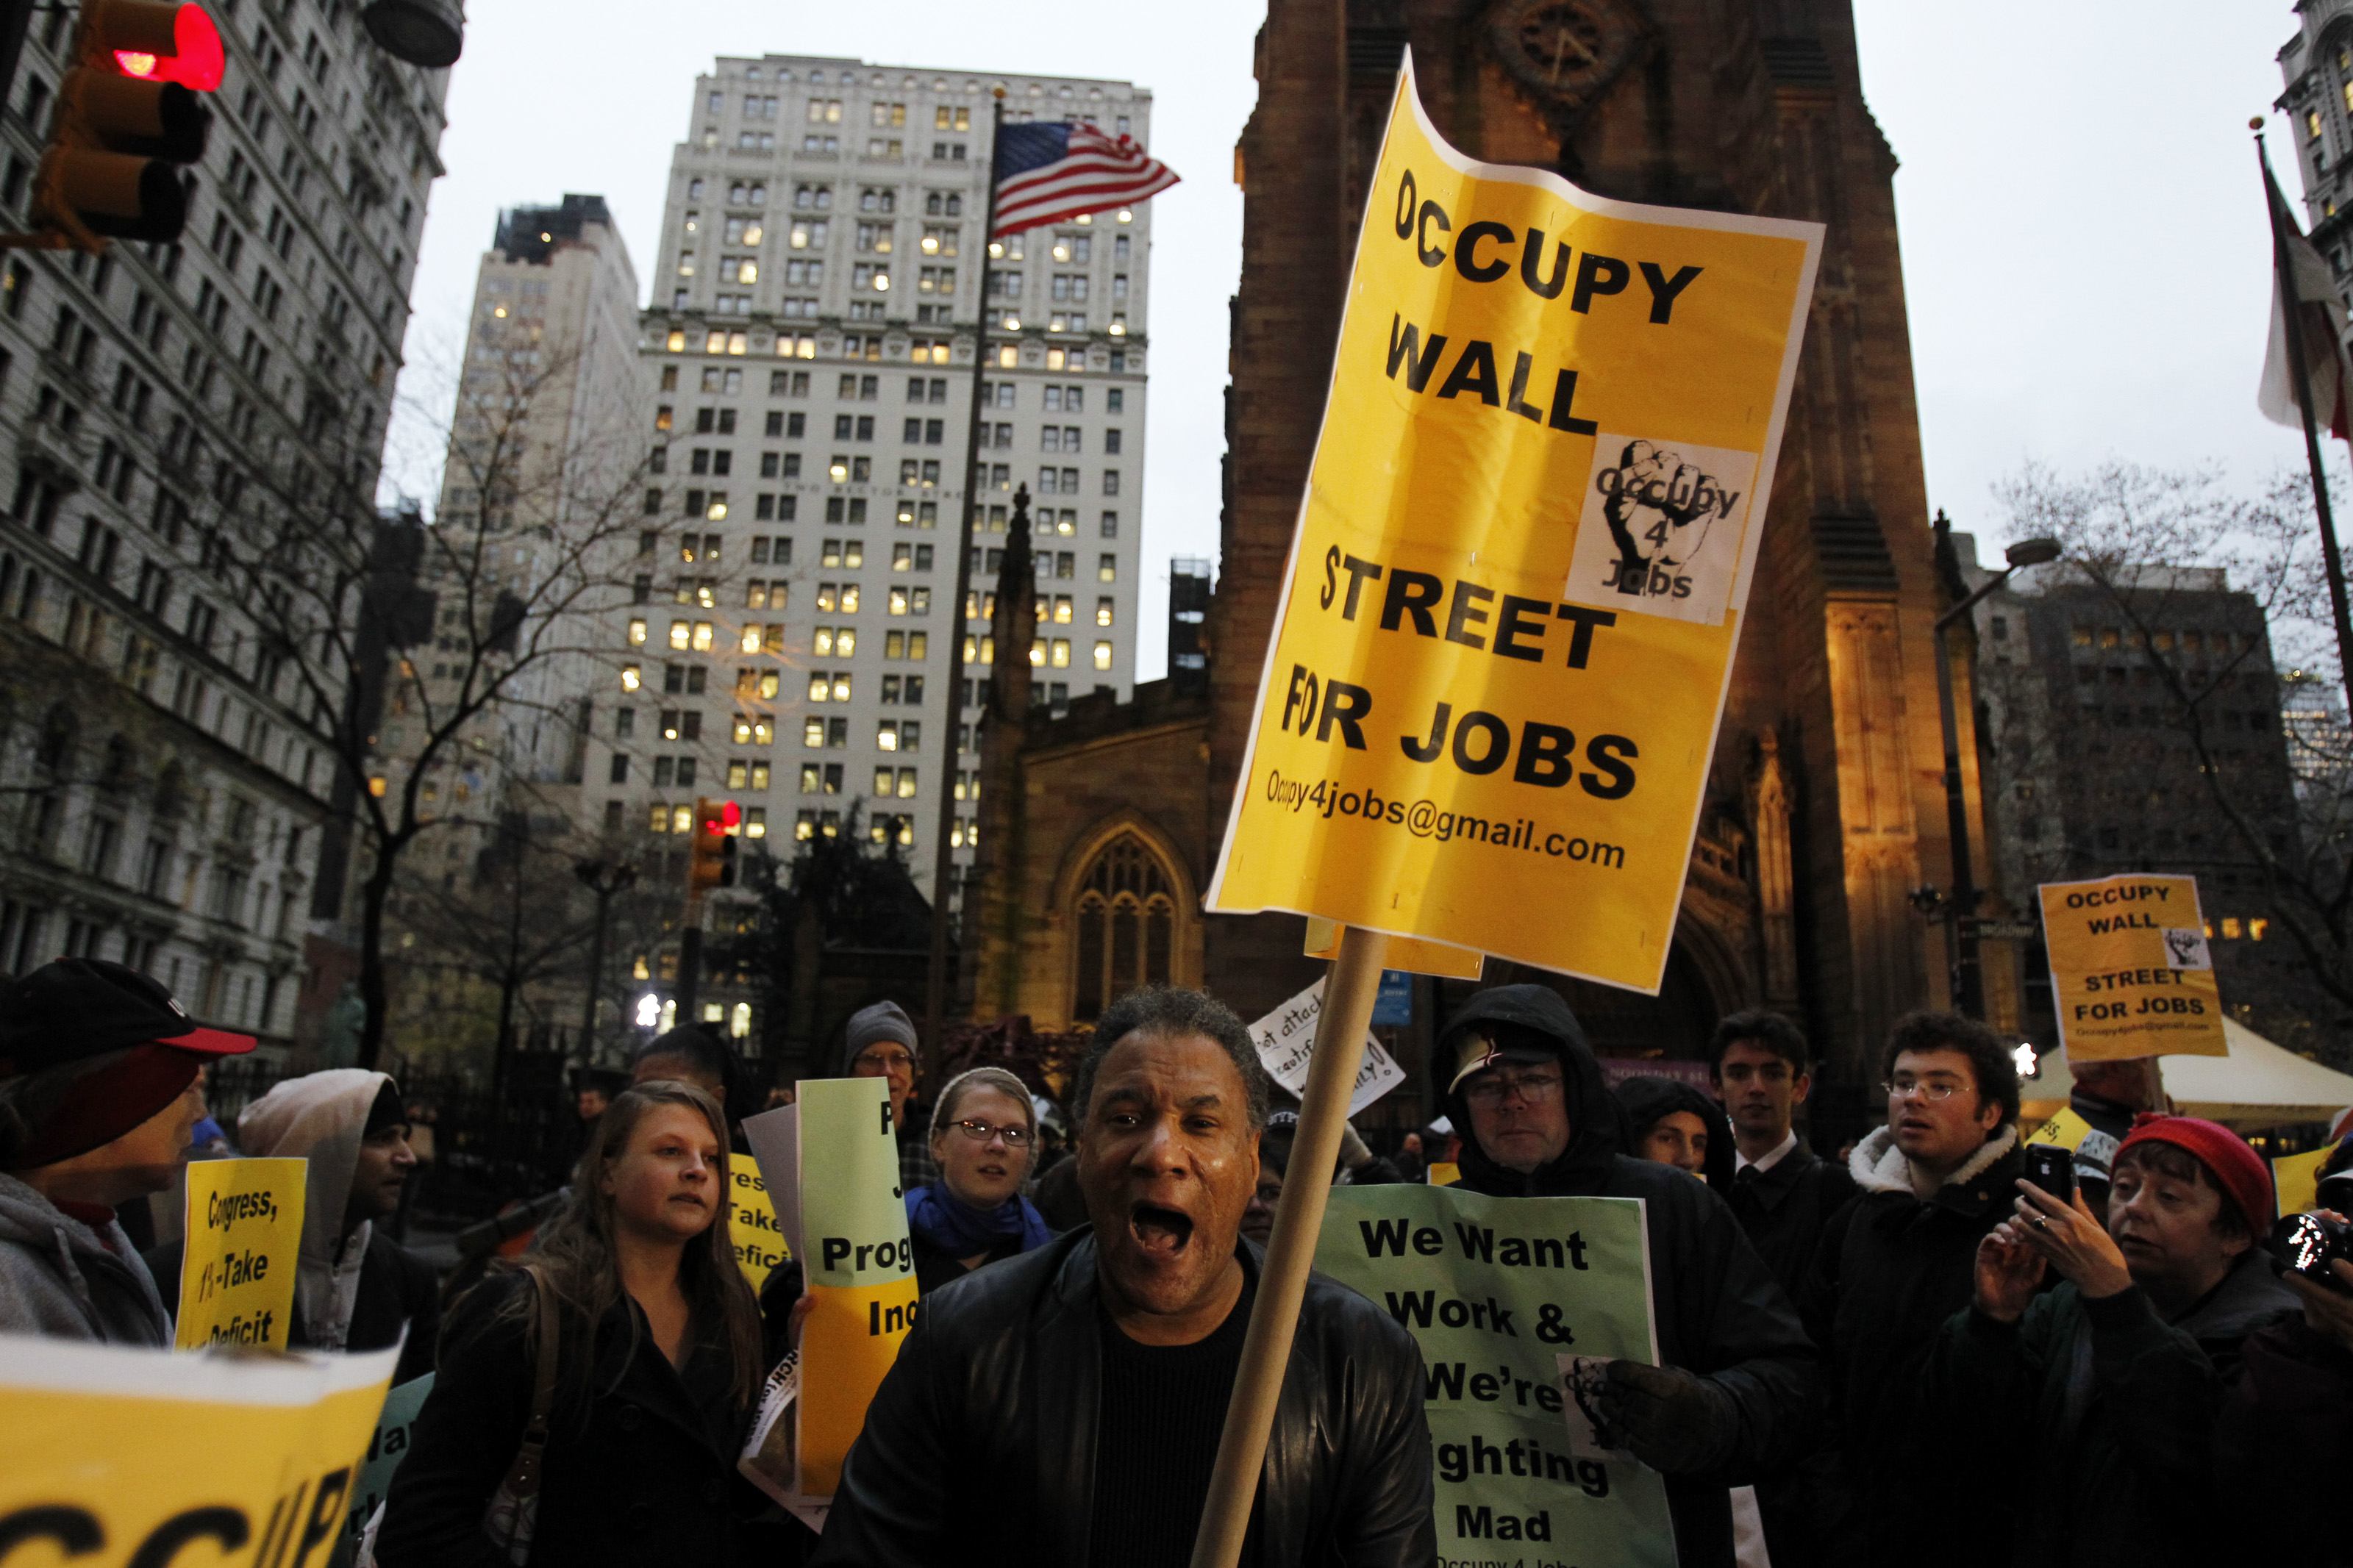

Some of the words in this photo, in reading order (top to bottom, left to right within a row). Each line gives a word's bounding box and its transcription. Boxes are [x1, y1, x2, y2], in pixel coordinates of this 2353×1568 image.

[1395, 168, 1703, 325] OCCUPY
[1385, 312, 1599, 437] WALL
[1596, 468, 1740, 519] Occupy
[1644, 520, 1668, 548] 4
[1602, 559, 1693, 598] Jobs
[1321, 544, 1616, 670] STREET
[1282, 663, 1372, 751] FOR
[1401, 701, 1639, 800] JOBS
[1268, 770, 1624, 869] Occupy4jobs@gmail.com
[2067, 885, 2169, 908] OCCUPY
[2088, 912, 2159, 935] WALL
[2085, 969, 2184, 992] STREET
[2075, 1002, 2127, 1020] FOR
[2136, 997, 2204, 1014] JOBS
[209, 1190, 277, 1233] Congress,
[1360, 1218, 1443, 1258] We
[1454, 1222, 1588, 1271] Want
[1385, 1289, 1518, 1337] Work
[1535, 1303, 1575, 1345] &
[1427, 1362, 1564, 1414] We're
[1456, 1504, 1552, 1542] Mad
